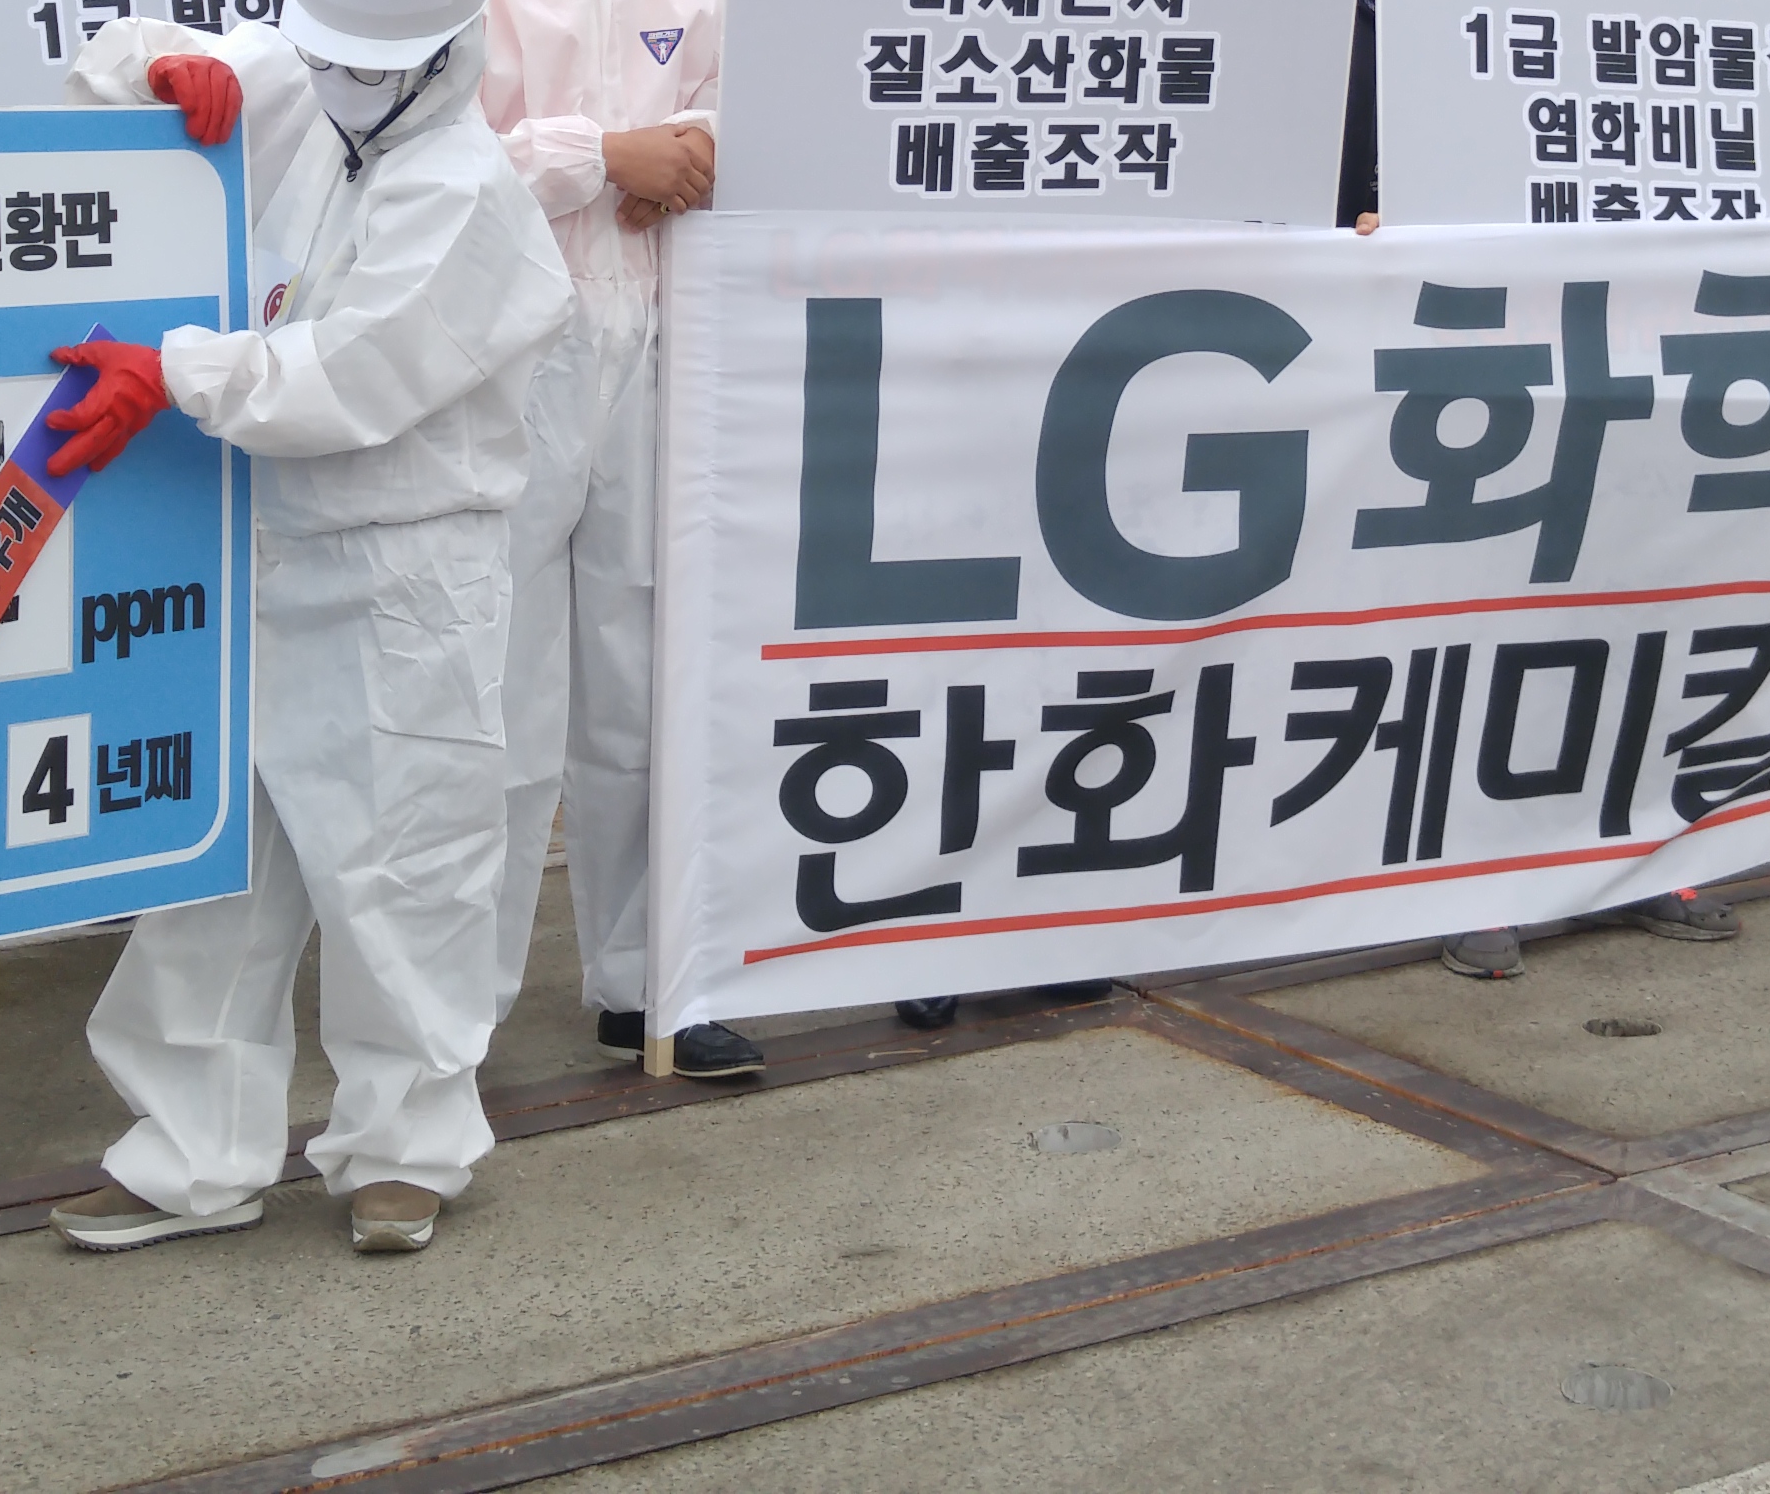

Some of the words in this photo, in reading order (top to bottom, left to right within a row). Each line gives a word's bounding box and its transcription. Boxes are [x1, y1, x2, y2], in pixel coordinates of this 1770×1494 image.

[863, 35, 1217, 107] 질소산화물
[1464, 13, 1559, 81] 1급
[896, 121, 1177, 194] 배출조작
[1527, 96, 1759, 173] 염화비닐
[80, 580, 205, 664] ppm
[21, 735, 75, 825] 4
[97, 731, 193, 814] 년째
